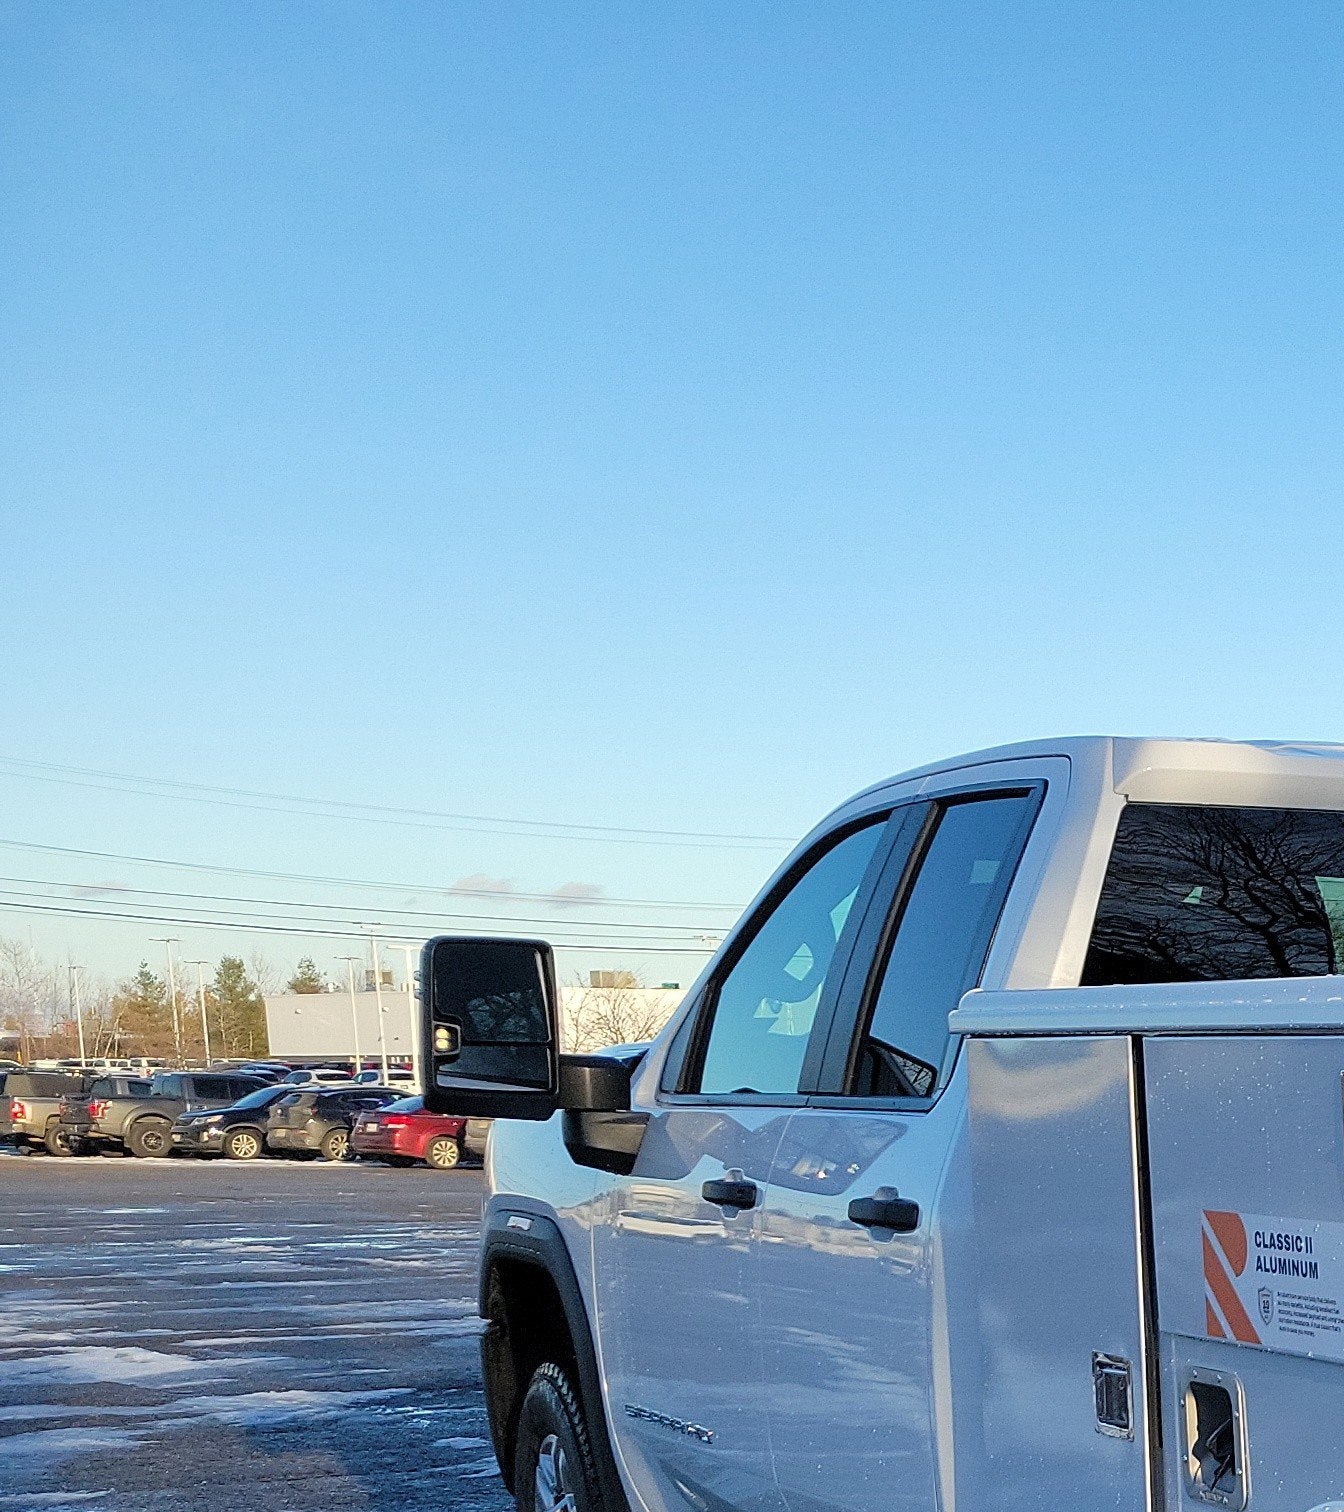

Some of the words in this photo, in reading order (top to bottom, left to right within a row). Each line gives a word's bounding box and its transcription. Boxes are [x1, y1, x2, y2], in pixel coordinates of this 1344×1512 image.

[1254, 1230, 1303, 1253] CLASSIC
[1305, 1236, 1313, 1254] II
[1256, 1255, 1319, 1279] ALUMINUM
